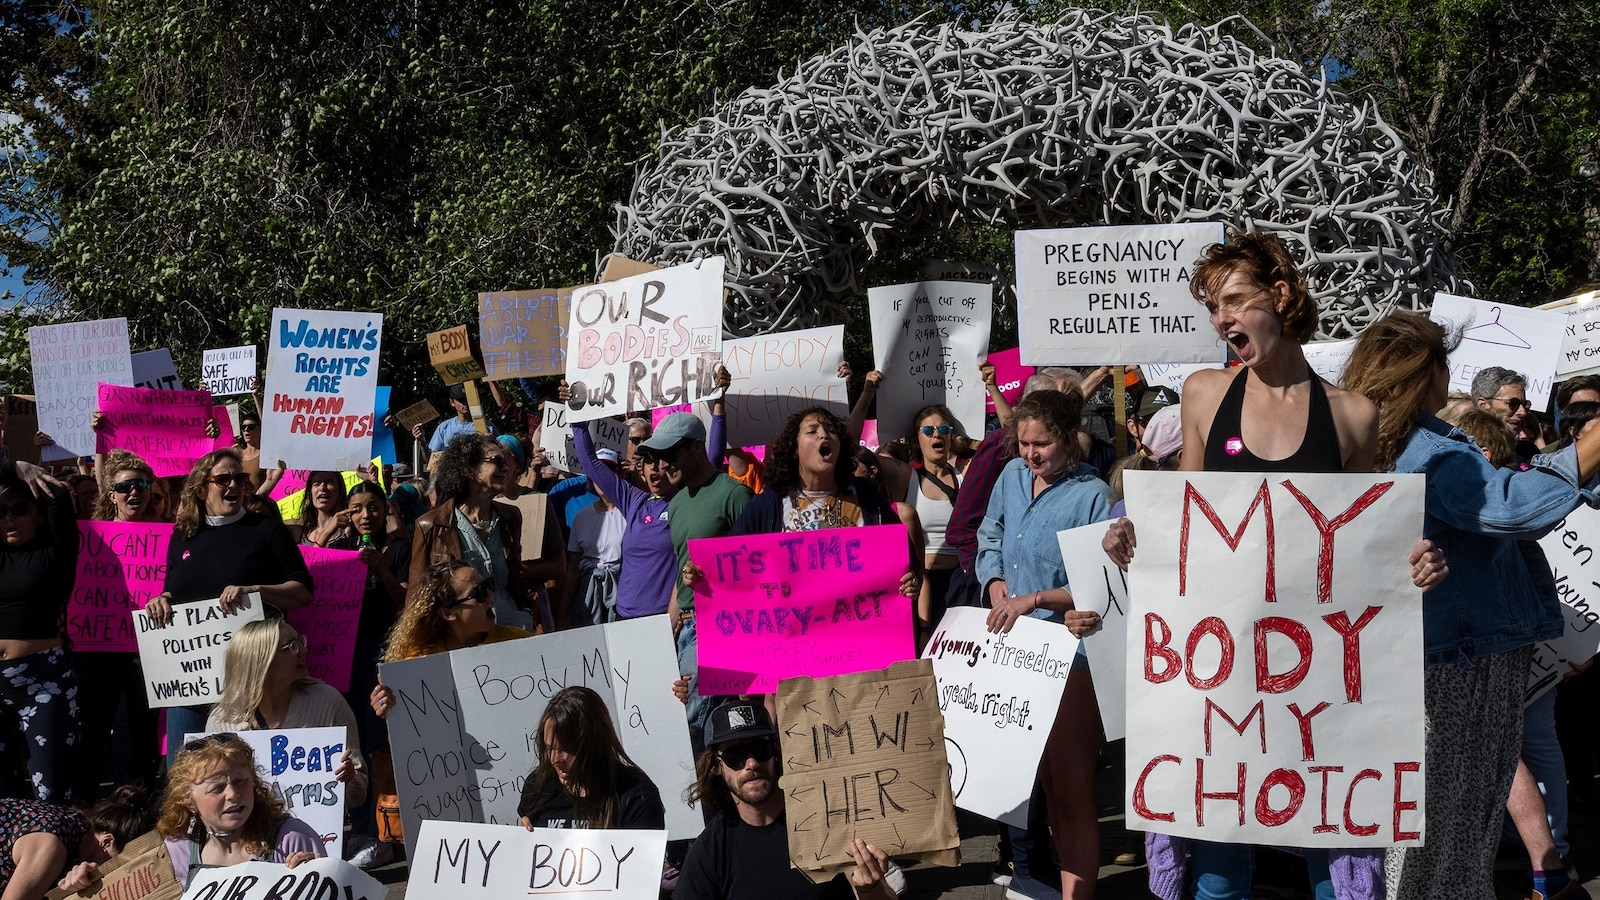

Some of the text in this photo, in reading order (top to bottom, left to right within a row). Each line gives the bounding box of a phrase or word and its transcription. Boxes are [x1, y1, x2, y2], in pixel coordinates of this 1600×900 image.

[1044, 238, 1185, 265] PREGNANCY
[938, 270, 993, 281] JACKSON
[1056, 266, 1191, 287] BEGINS WITH A
[575, 280, 670, 328] OUR
[893, 299, 903, 312] IF
[1088, 291, 1158, 311] PENIS.
[30, 320, 126, 346] BANS OFF OUR BODIES
[916, 315, 976, 327] REPRODUCTIVE
[1049, 315, 1196, 335] REGULATE THAT.
[1565, 324, 1576, 337] Y
[280, 319, 378, 351] WOMEN'S
[430, 328, 468, 356] MY BODY
[479, 321, 538, 348] WAR
[694, 334, 713, 346] ARE
[915, 327, 949, 342] RIGHTS
[31, 340, 126, 364] BANS OFF OUR BODIES
[295, 352, 370, 377] RIGHTS
[482, 350, 544, 377] THE
[764, 335, 832, 373] BODY
[909, 346, 953, 362] CAN I
[1565, 350, 1580, 362] MY
[33, 357, 126, 382] BANS OFF OUR BODIES
[203, 363, 228, 379] SAFE
[445, 359, 480, 378] CHOICE
[305, 375, 342, 393] ARE
[567, 372, 617, 411] OUR
[9, 397, 36, 416] KEE
[273, 393, 344, 415] HUMAN
[290, 412, 374, 438] RIGHTS!
[110, 528, 161, 558] CAN'T
[1179, 478, 1395, 604] MY
[83, 561, 167, 581] ABORTIONS
[715, 535, 865, 584] IT'S TIME
[74, 586, 108, 608] CAN
[760, 580, 792, 600] TO
[715, 589, 889, 637] OVARY-ACT
[68, 613, 116, 641] SAFE
[163, 631, 232, 655] POLITICS
[928, 630, 1070, 680] Wyoming: freedom
[1144, 605, 1384, 704] BODY
[180, 656, 212, 673] WITH
[151, 675, 210, 700] WOMEN'S
[399, 680, 465, 746] My
[583, 647, 631, 710] My
[981, 693, 1033, 731] right.
[812, 721, 855, 763] IM
[1202, 697, 1333, 762] MY
[270, 734, 344, 776] Bear
[406, 737, 507, 786] Choice
[822, 768, 910, 828] HER
[1132, 754, 1422, 842] CHOICE
[434, 838, 635, 890] MY BODY
